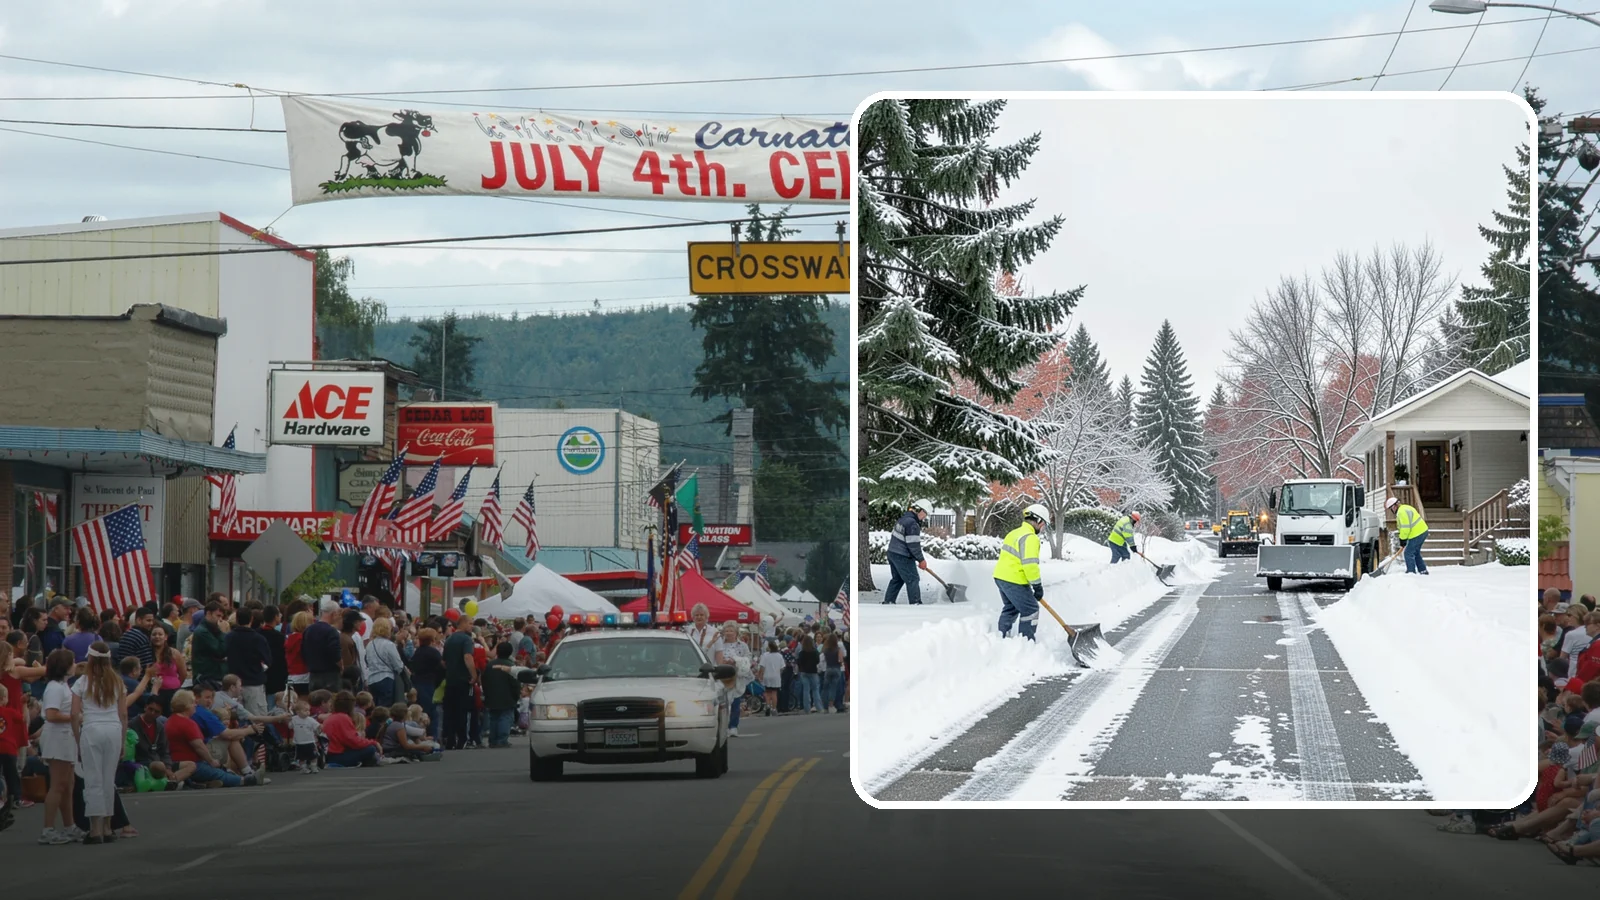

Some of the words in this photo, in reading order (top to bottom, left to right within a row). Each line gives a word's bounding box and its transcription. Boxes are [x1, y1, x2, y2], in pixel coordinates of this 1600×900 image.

[481, 141, 605, 192] JULY
[632, 150, 746, 198] 4th.
[697, 254, 850, 280] CROSSWA
[282, 379, 374, 420] ACE
[406, 408, 452, 422] CEDAR
[461, 409, 485, 422] LOG
[283, 421, 371, 437] Hardware
[416, 428, 477, 447] Coca-Cola
[96, 485, 124, 495] Vincent
[126, 485, 136, 495] de
[137, 486, 155, 496] Paul
[212, 515, 331, 536] HARDARE
[688, 526, 741, 535] CRNATION
[699, 535, 730, 544] GLASS
